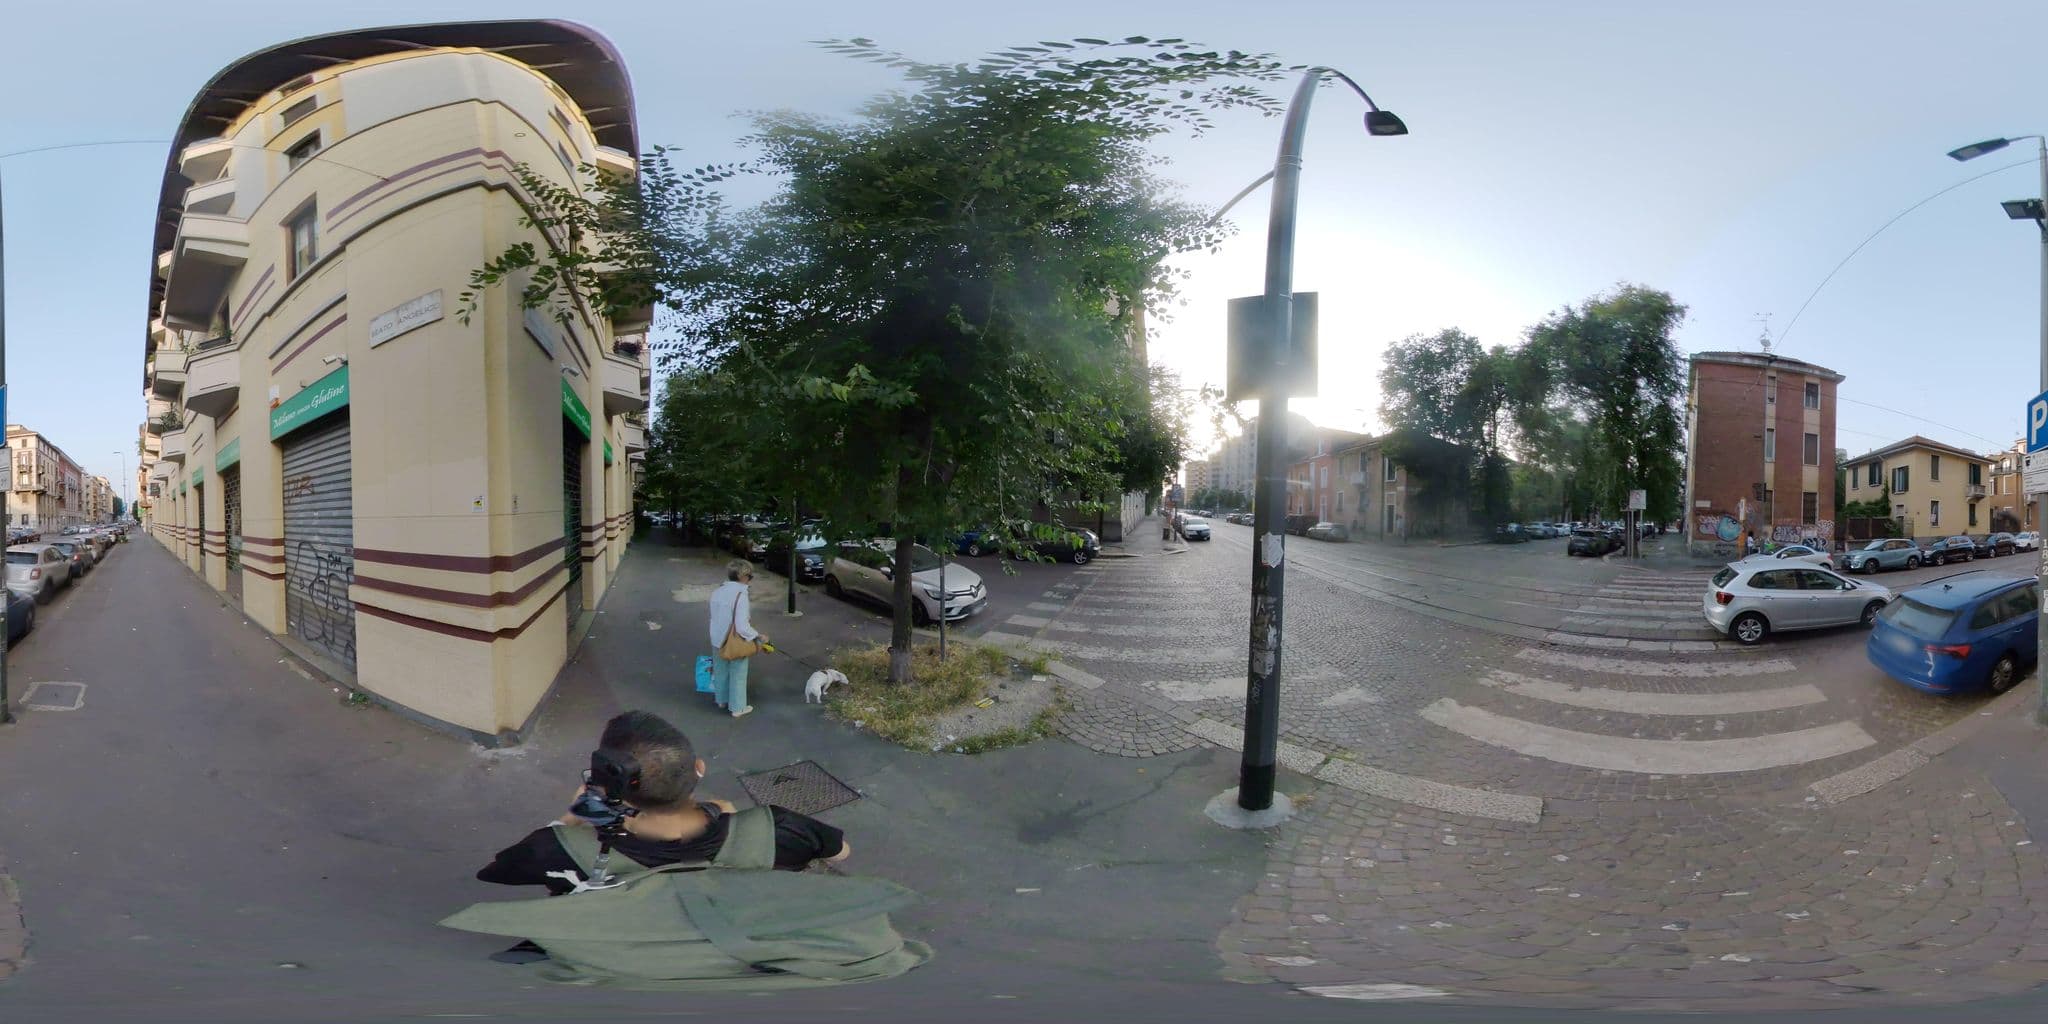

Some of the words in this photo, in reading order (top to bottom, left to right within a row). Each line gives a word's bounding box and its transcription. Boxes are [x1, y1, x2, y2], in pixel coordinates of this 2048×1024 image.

[273, 411, 296, 429] Milano
[311, 385, 345, 408] Glutine
[2031, 399, 2048, 446] P
